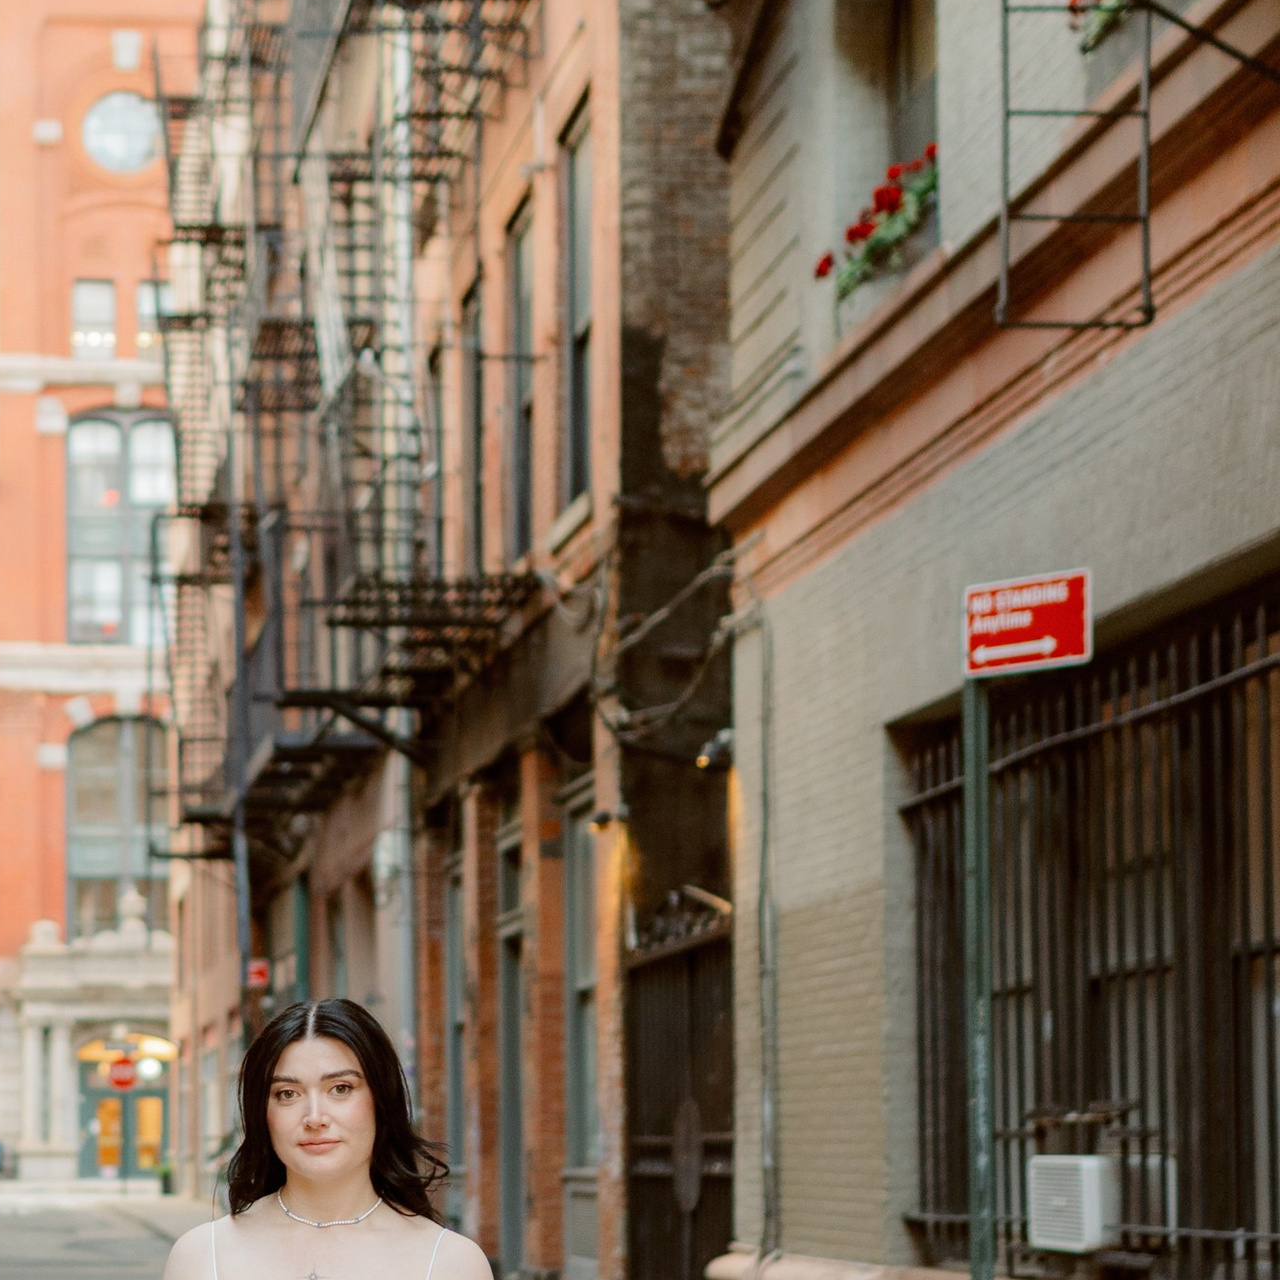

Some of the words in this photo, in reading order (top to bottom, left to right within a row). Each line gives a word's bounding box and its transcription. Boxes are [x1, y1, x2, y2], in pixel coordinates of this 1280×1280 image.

[972, 592, 992, 614] NO
[996, 580, 1069, 612] STANDING
[972, 610, 1033, 635] Anytime
